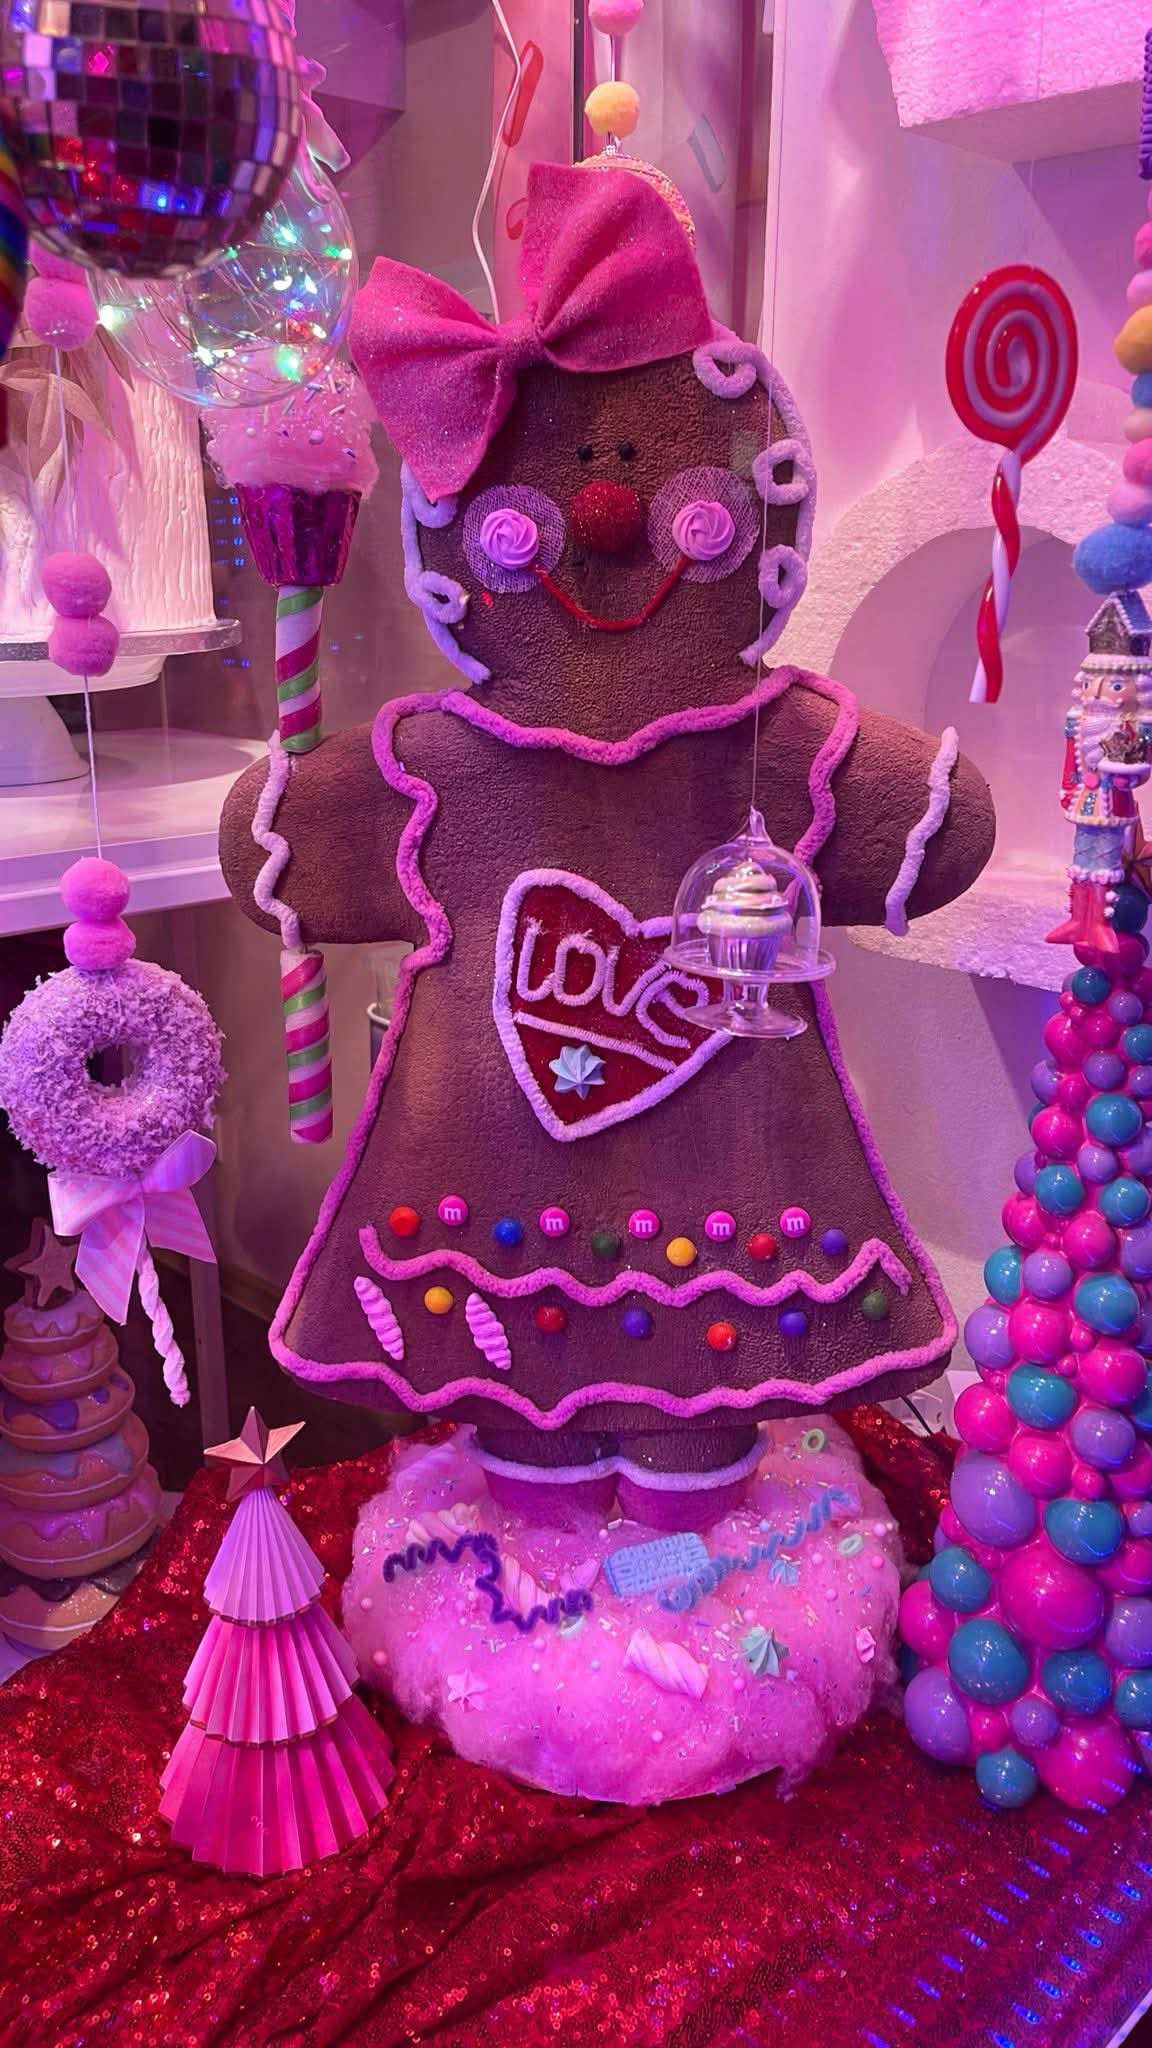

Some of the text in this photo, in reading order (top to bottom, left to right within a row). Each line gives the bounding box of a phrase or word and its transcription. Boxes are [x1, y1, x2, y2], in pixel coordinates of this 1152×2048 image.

[444, 1207, 461, 1221] m
[546, 1217, 564, 1231] m
[635, 1219, 653, 1232] m
[712, 1221, 730, 1235] m
[786, 1216, 805, 1230] m
